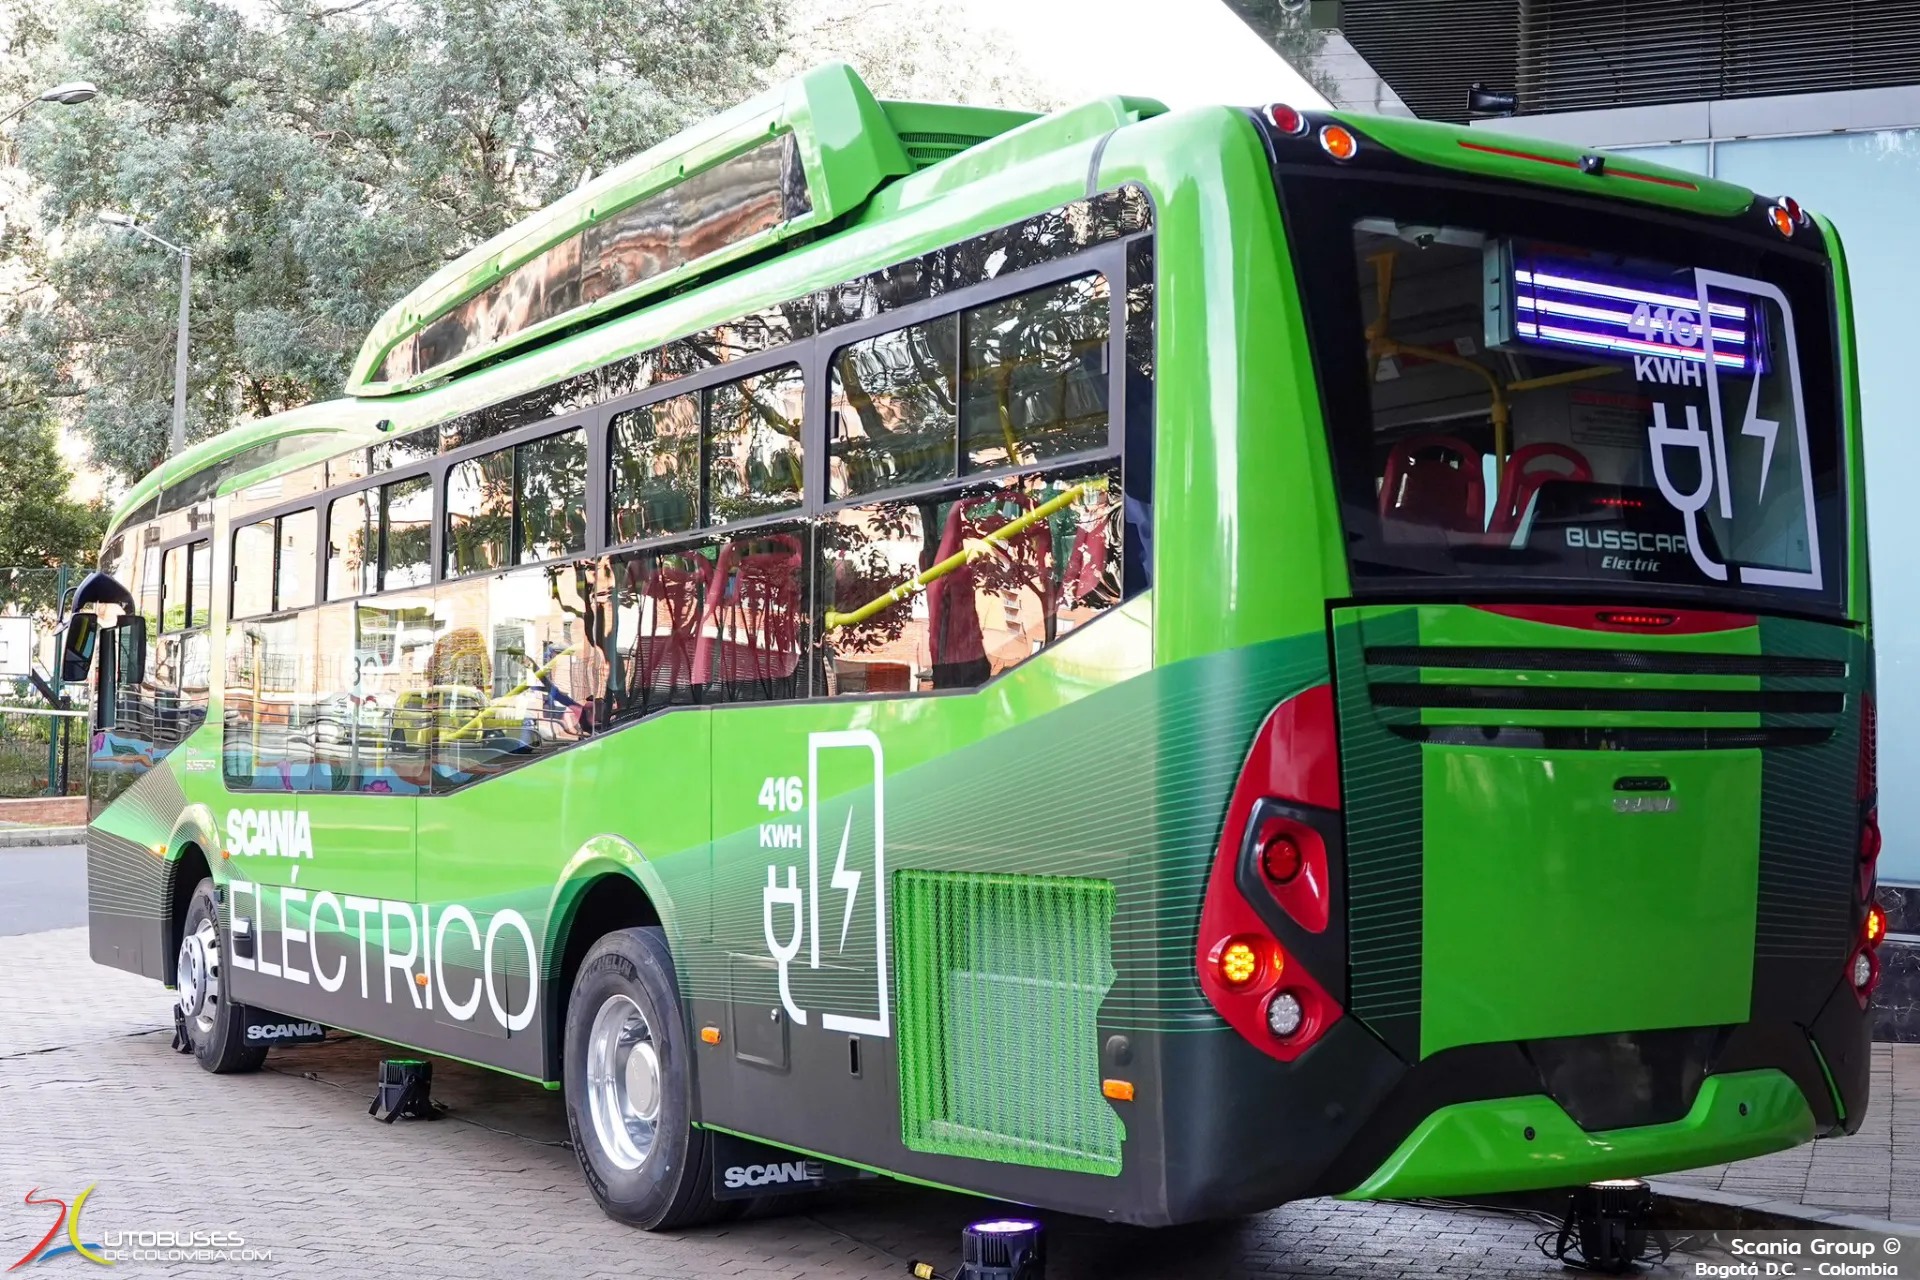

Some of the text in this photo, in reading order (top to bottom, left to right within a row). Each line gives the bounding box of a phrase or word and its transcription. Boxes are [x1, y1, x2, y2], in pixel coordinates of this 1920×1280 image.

[1628, 302, 1698, 347] 416
[1634, 355, 1702, 387] KWH
[1565, 527, 1689, 554] BUSSCAR
[1601, 555, 1662, 573] Electric
[758, 776, 803, 812] 416
[226, 808, 314, 859] SCANIA
[760, 823, 802, 848] KWH
[229, 865, 538, 1031] ELÉCTRICO
[247, 1023, 323, 1039] SCANIA
[724, 1160, 819, 1188] SCANI
